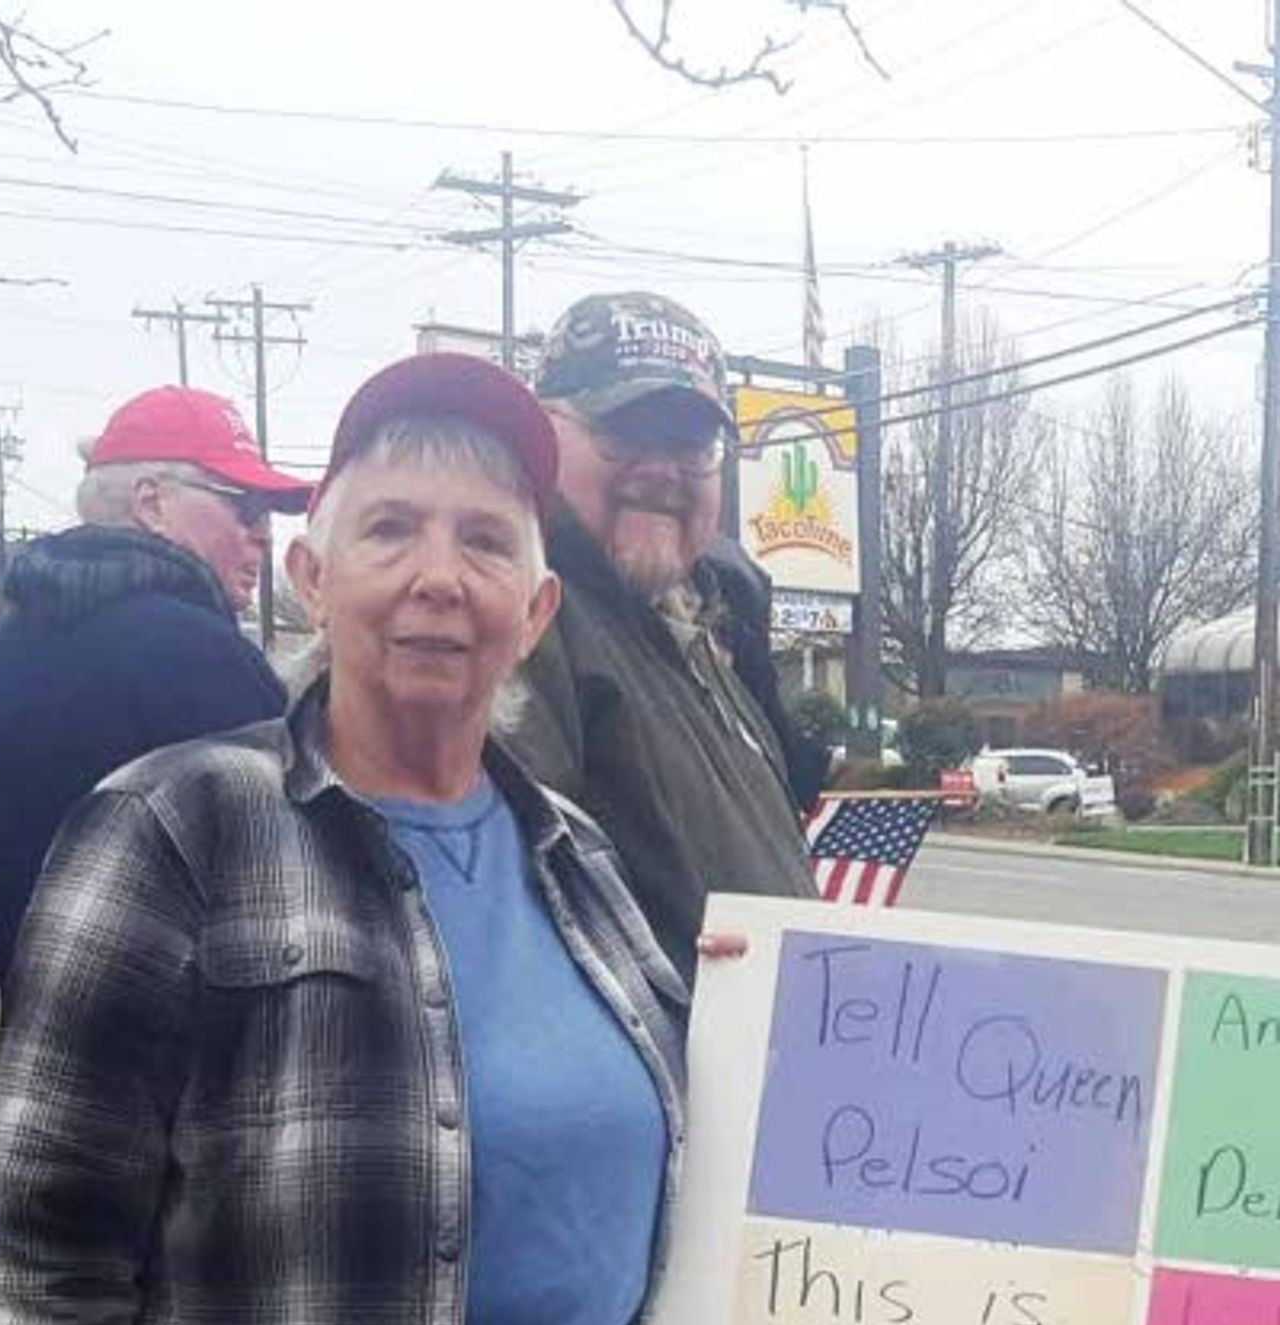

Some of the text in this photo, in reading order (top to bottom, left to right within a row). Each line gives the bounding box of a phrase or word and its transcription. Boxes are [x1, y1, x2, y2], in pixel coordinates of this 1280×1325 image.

[610, 314, 713, 362] Trump
[747, 513, 853, 566] TacoTime
[803, 945, 1141, 1140] Tell Queen
[821, 1105, 1045, 1201] Pelsoi
[754, 1236, 914, 1324] This
